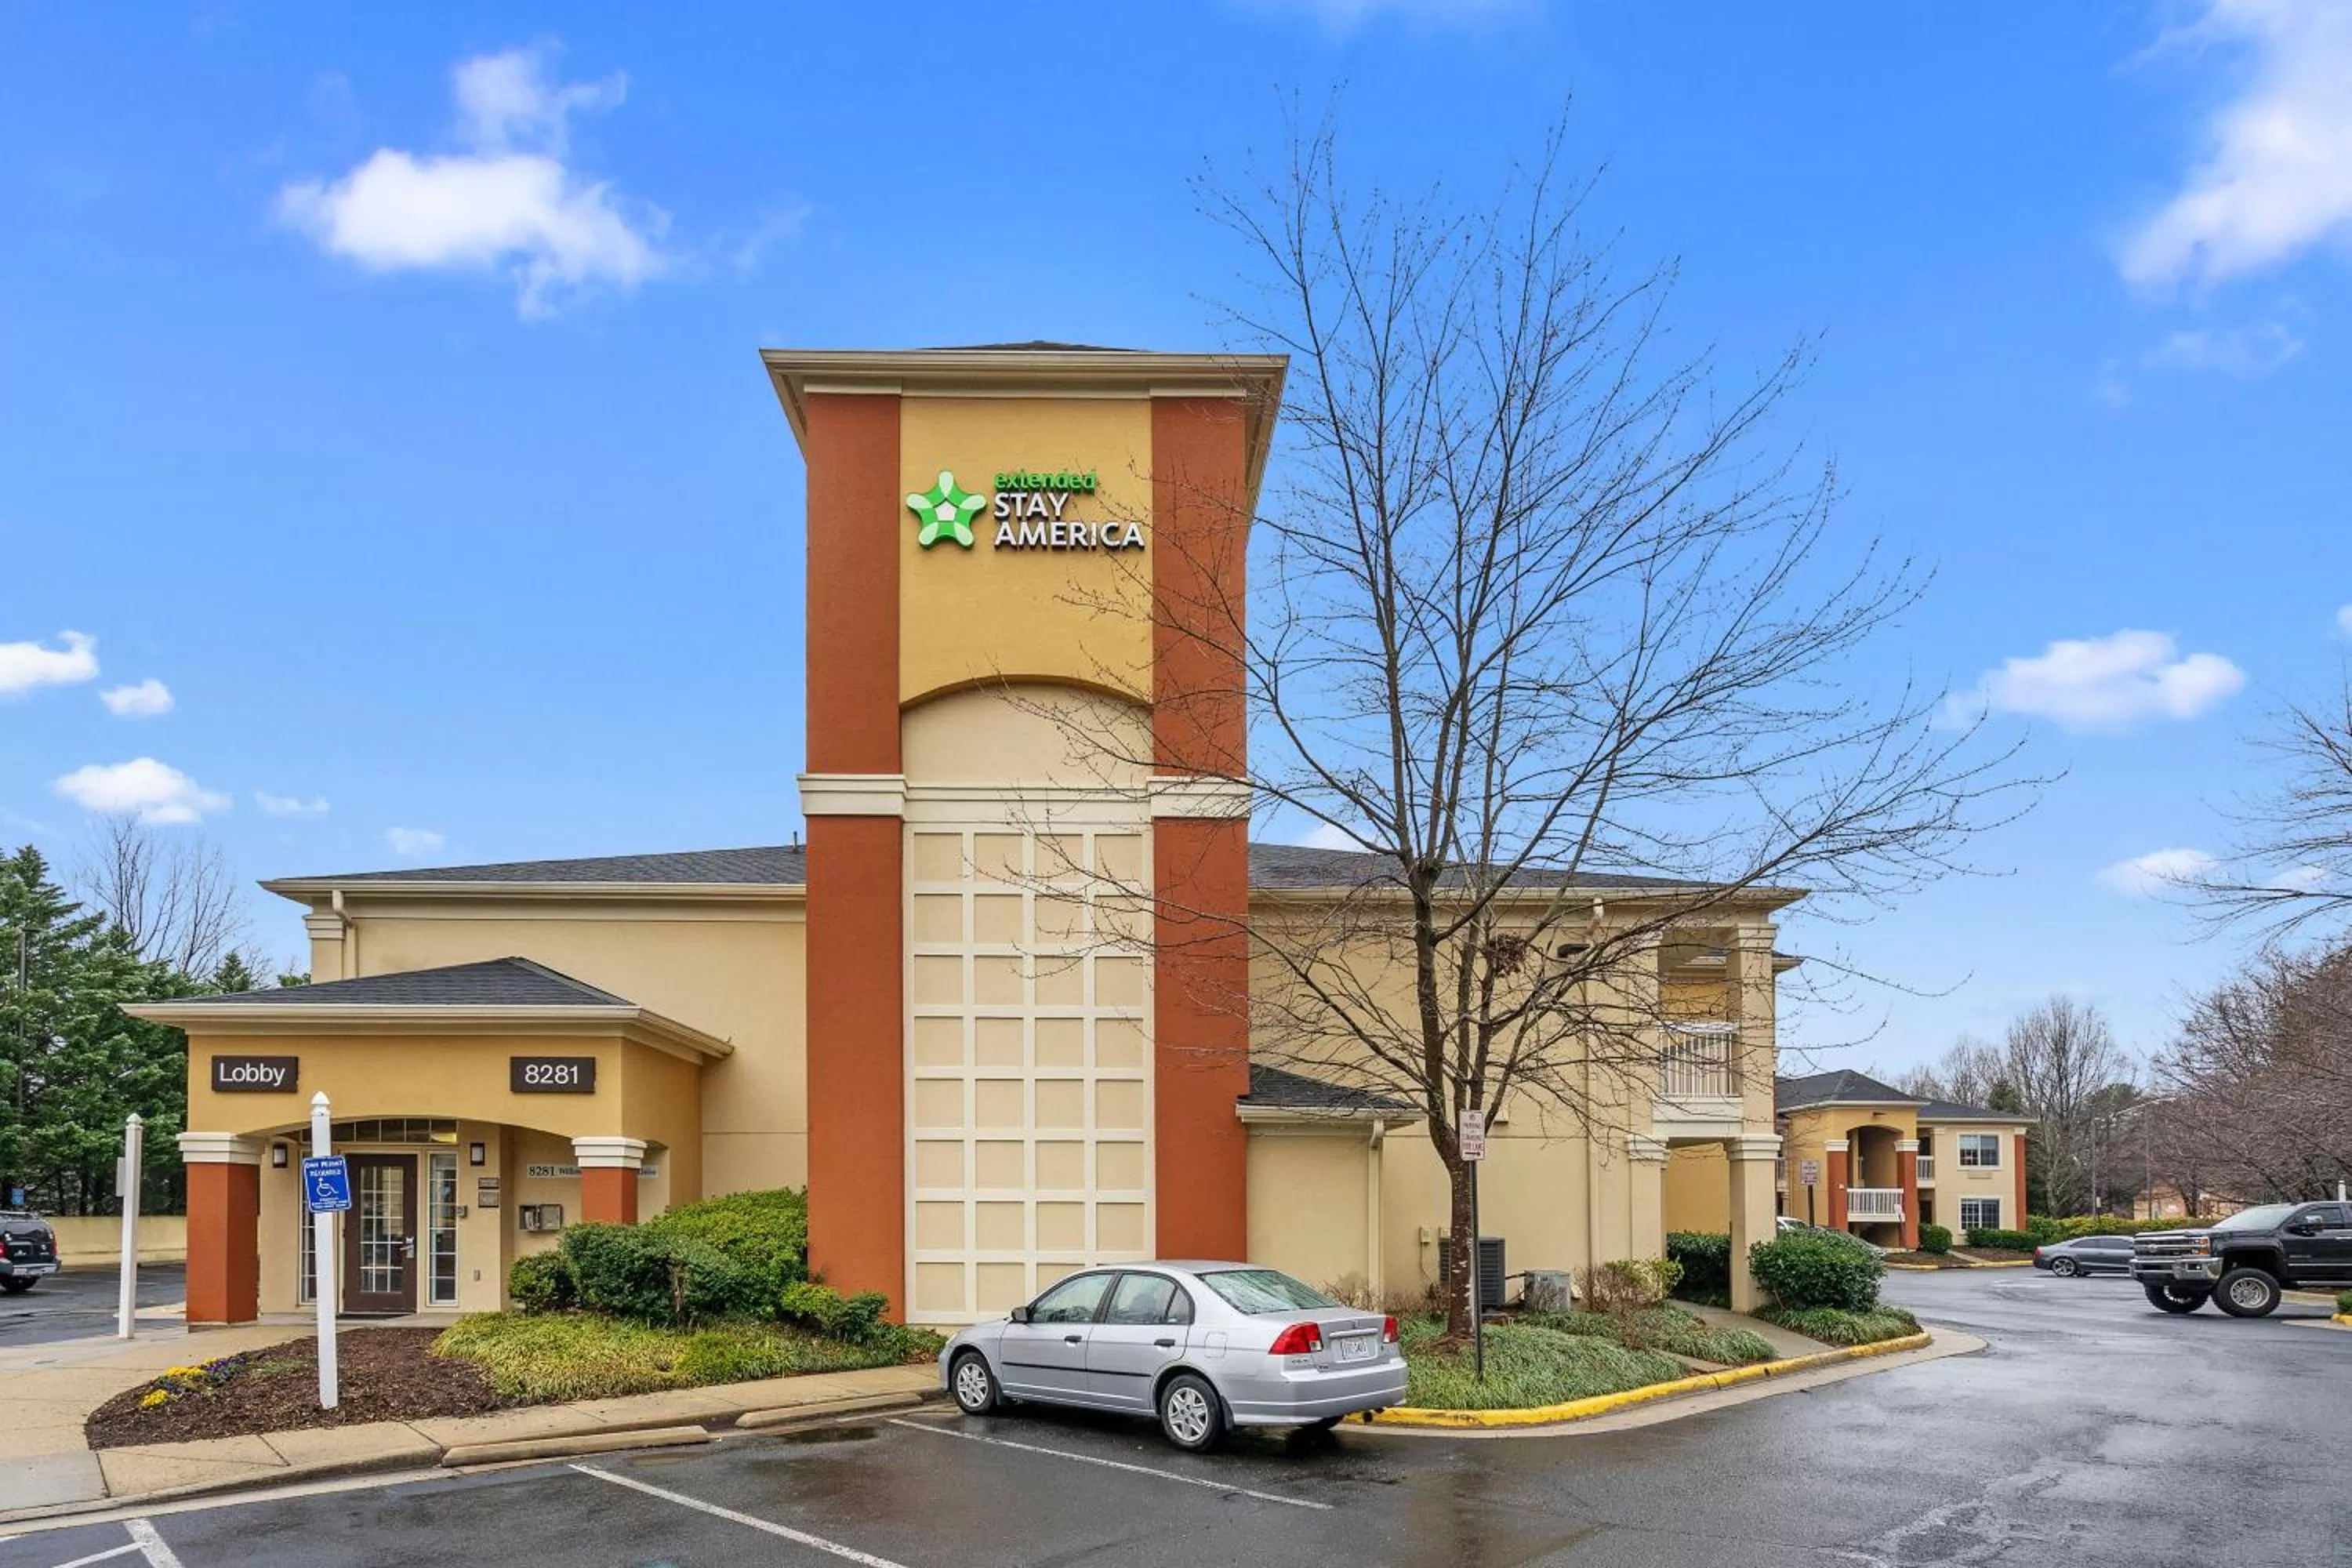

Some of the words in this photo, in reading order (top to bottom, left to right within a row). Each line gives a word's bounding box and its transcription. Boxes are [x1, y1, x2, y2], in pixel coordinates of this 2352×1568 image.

[993, 469, 1095, 492] extended
[994, 492, 1069, 518] STAY
[993, 521, 1145, 547] AMERICA
[220, 1062, 285, 1087] Lobby
[524, 1064, 578, 1084] 8281
[529, 1166, 555, 1177] 8281
